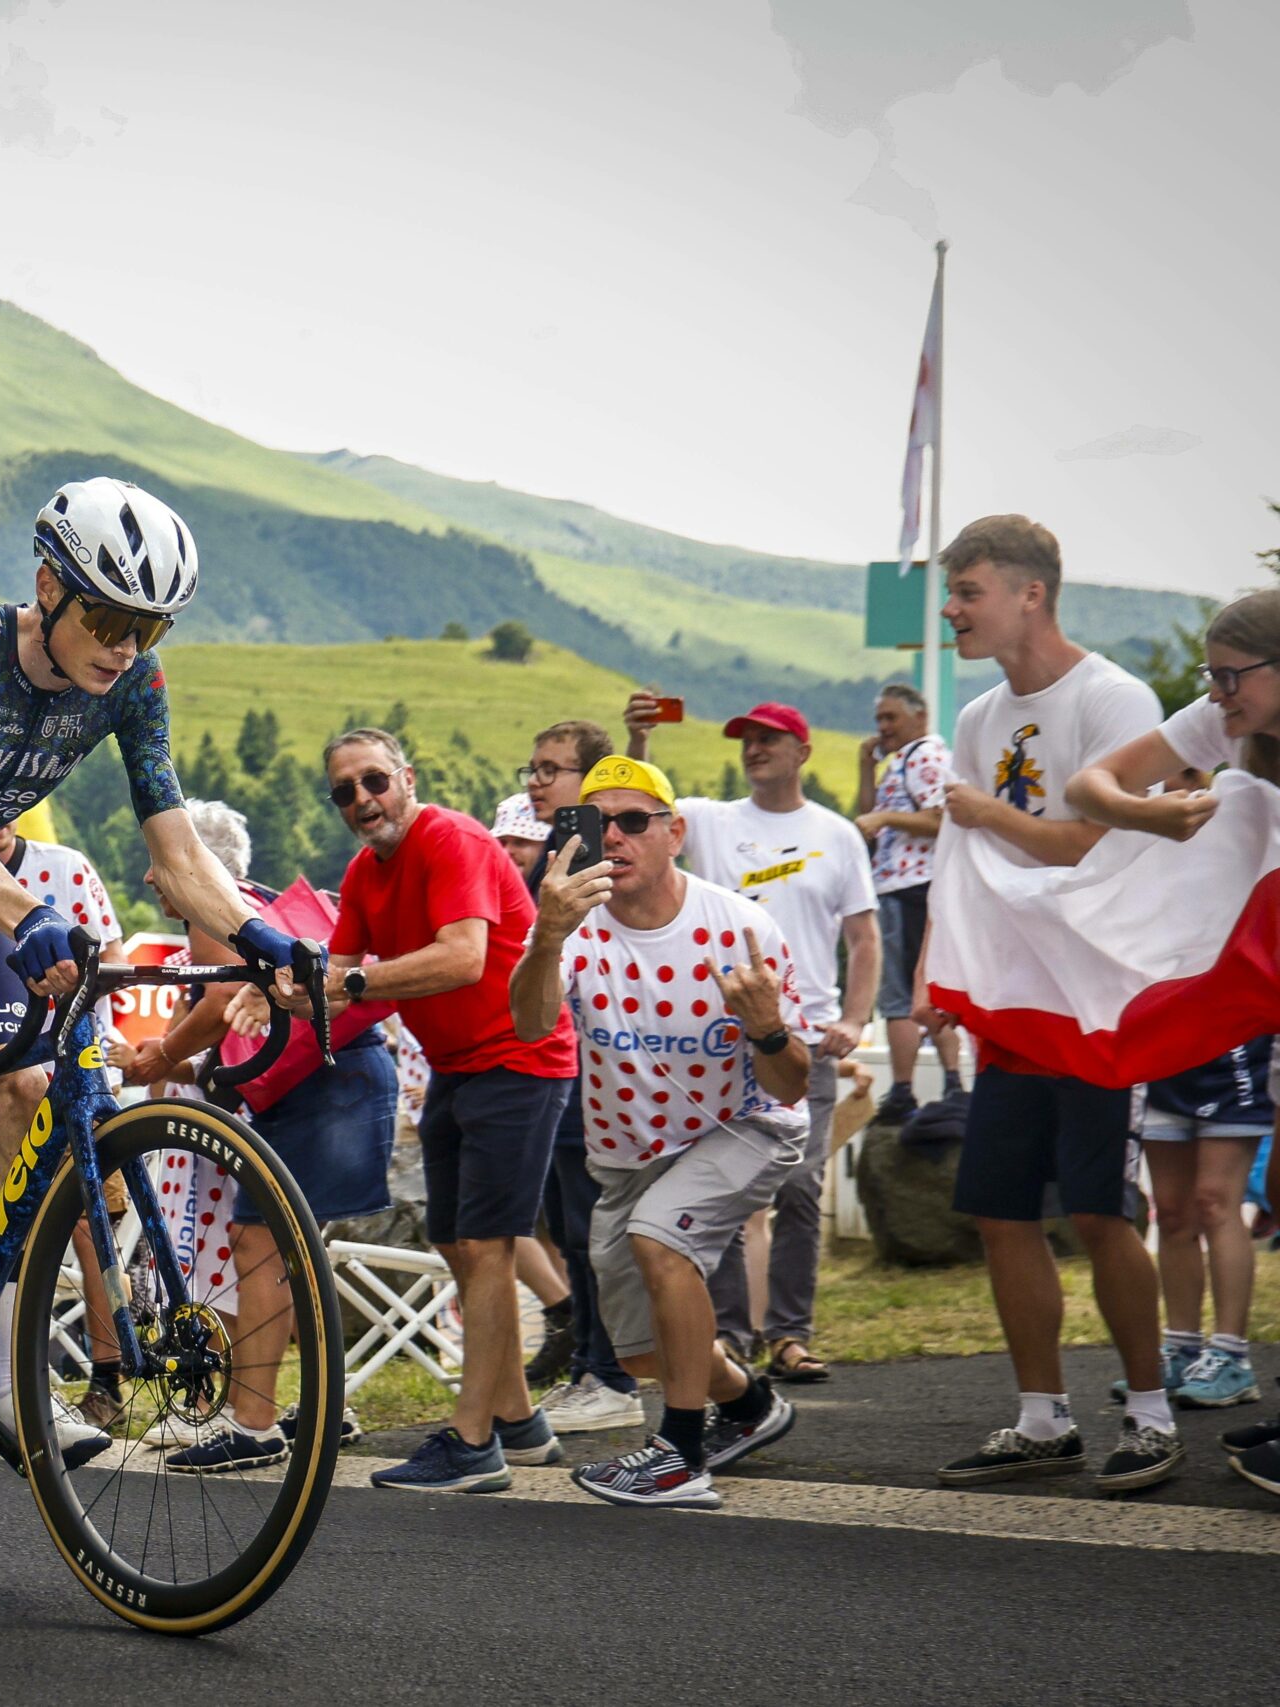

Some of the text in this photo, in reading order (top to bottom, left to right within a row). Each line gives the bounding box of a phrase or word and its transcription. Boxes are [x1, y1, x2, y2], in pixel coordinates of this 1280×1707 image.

[56, 519, 92, 564] GIRO
[125, 567, 141, 595] VISMA
[57, 725, 83, 739] CITY
[60, 713, 84, 726] BET
[112, 983, 180, 1019] STO
[166, 1121, 243, 1172] RESERVE
[76, 1548, 148, 1608] RESERVE
